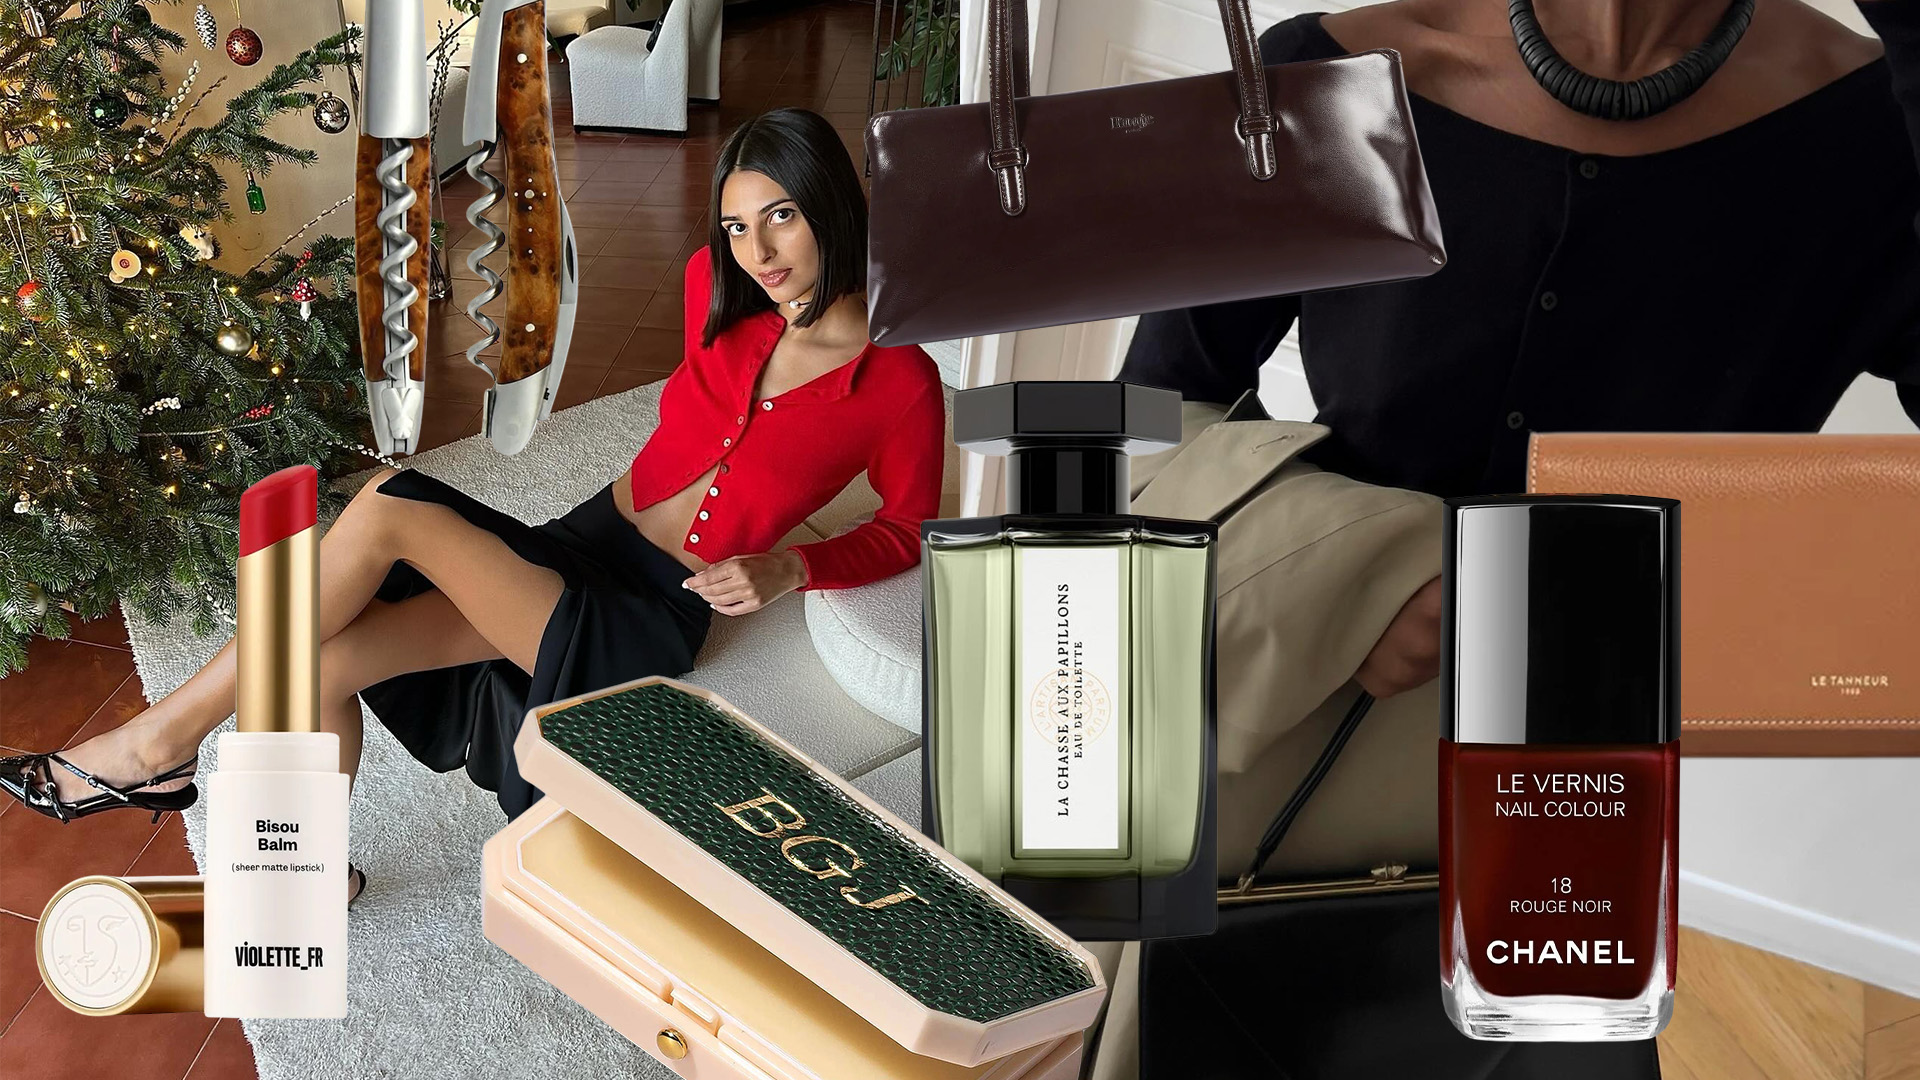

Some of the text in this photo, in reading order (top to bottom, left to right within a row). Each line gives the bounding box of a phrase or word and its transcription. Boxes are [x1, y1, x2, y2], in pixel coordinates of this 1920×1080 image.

[1811, 675, 1889, 687] LE TANNEUR
[1057, 583, 1069, 816] LA CHASSE AUX PAPILLONS
[1074, 641, 1083, 759] EAU DE TOILETTE
[1497, 773, 1625, 794] LE VERNIS
[1495, 801, 1626, 817] NAIL COLOUR
[255, 819, 300, 834] Bisou
[257, 837, 298, 851] Balm
[713, 786, 930, 910] BGJ
[231, 862, 325, 873] (sheer matte lipstick)
[1551, 877, 1572, 894] 18
[1510, 899, 1612, 913] ROUGE NOIR
[1486, 939, 1635, 965] CHANEL
